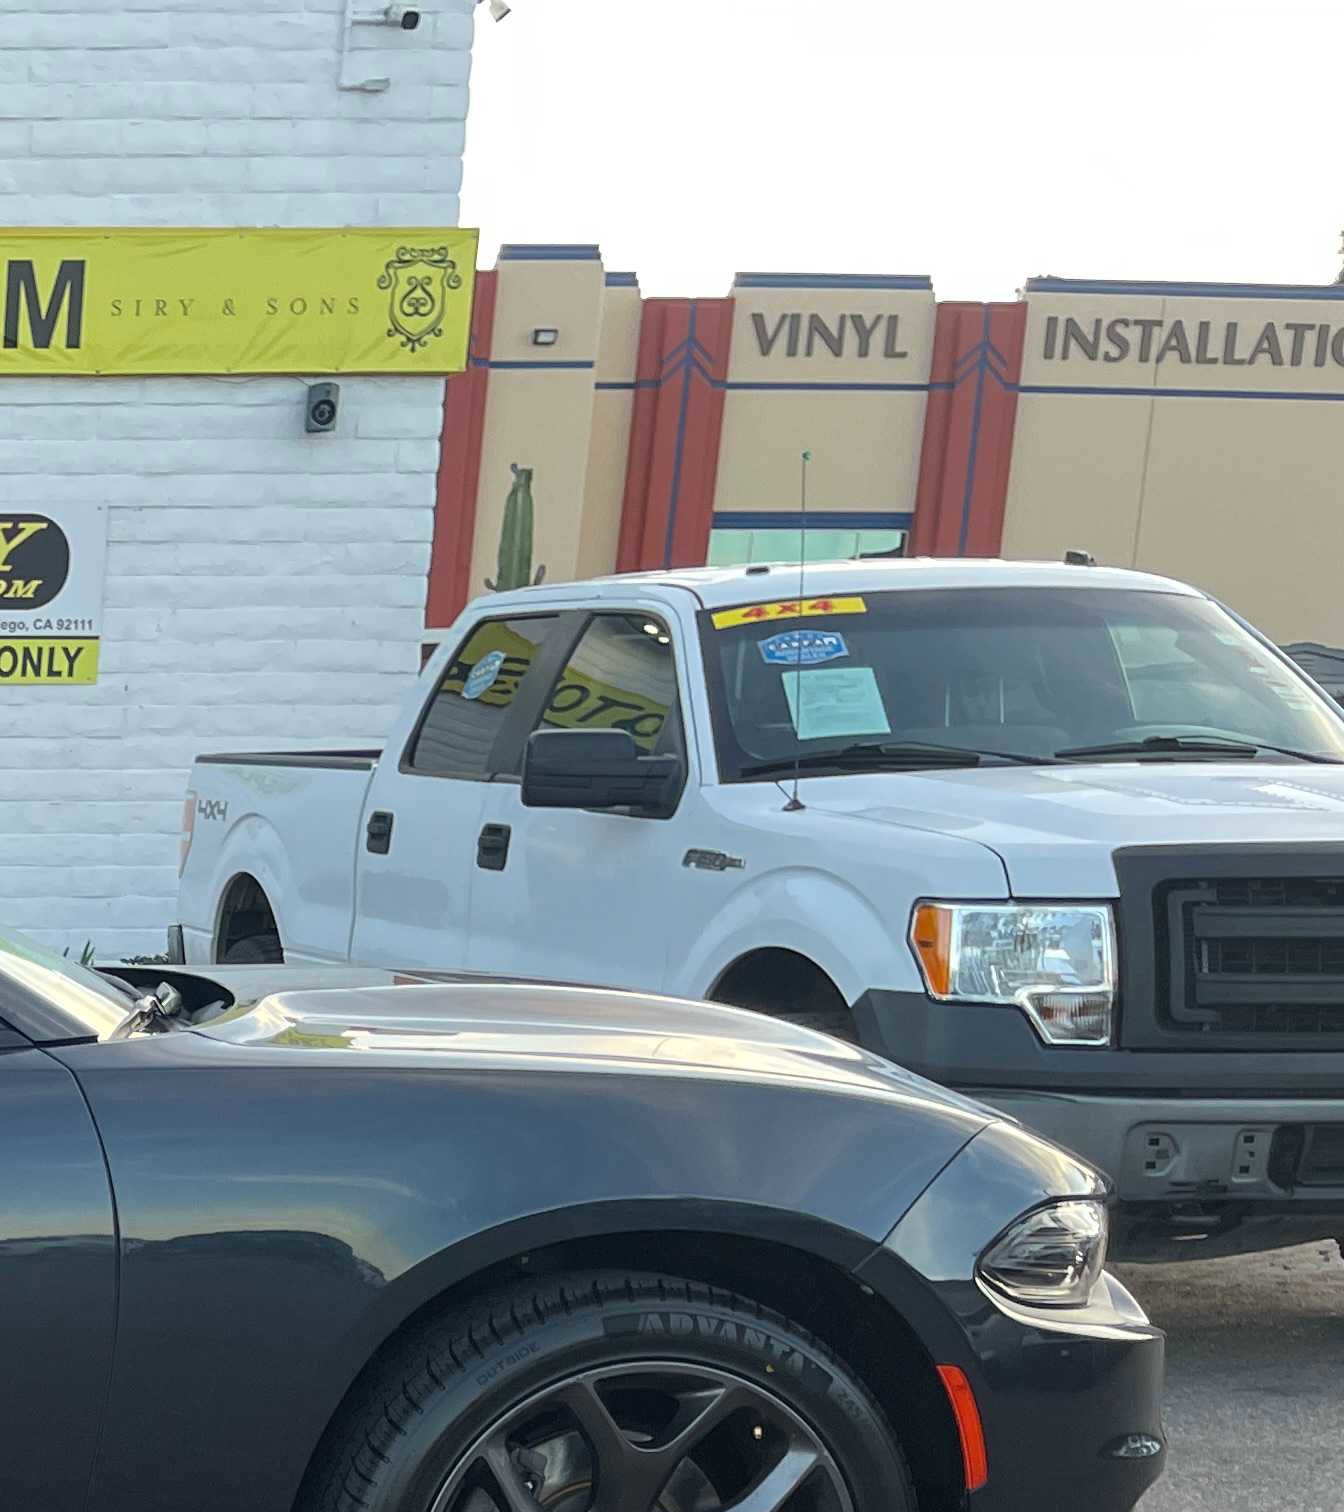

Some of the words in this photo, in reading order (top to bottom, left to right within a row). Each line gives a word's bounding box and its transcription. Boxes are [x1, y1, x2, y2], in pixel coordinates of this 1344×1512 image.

[111, 299, 196, 317] SIRY
[221, 299, 236, 317] &
[265, 297, 361, 316] SONS
[751, 312, 909, 359] VINYL
[33, 619, 53, 631] CA
[57, 619, 94, 631] 92111
